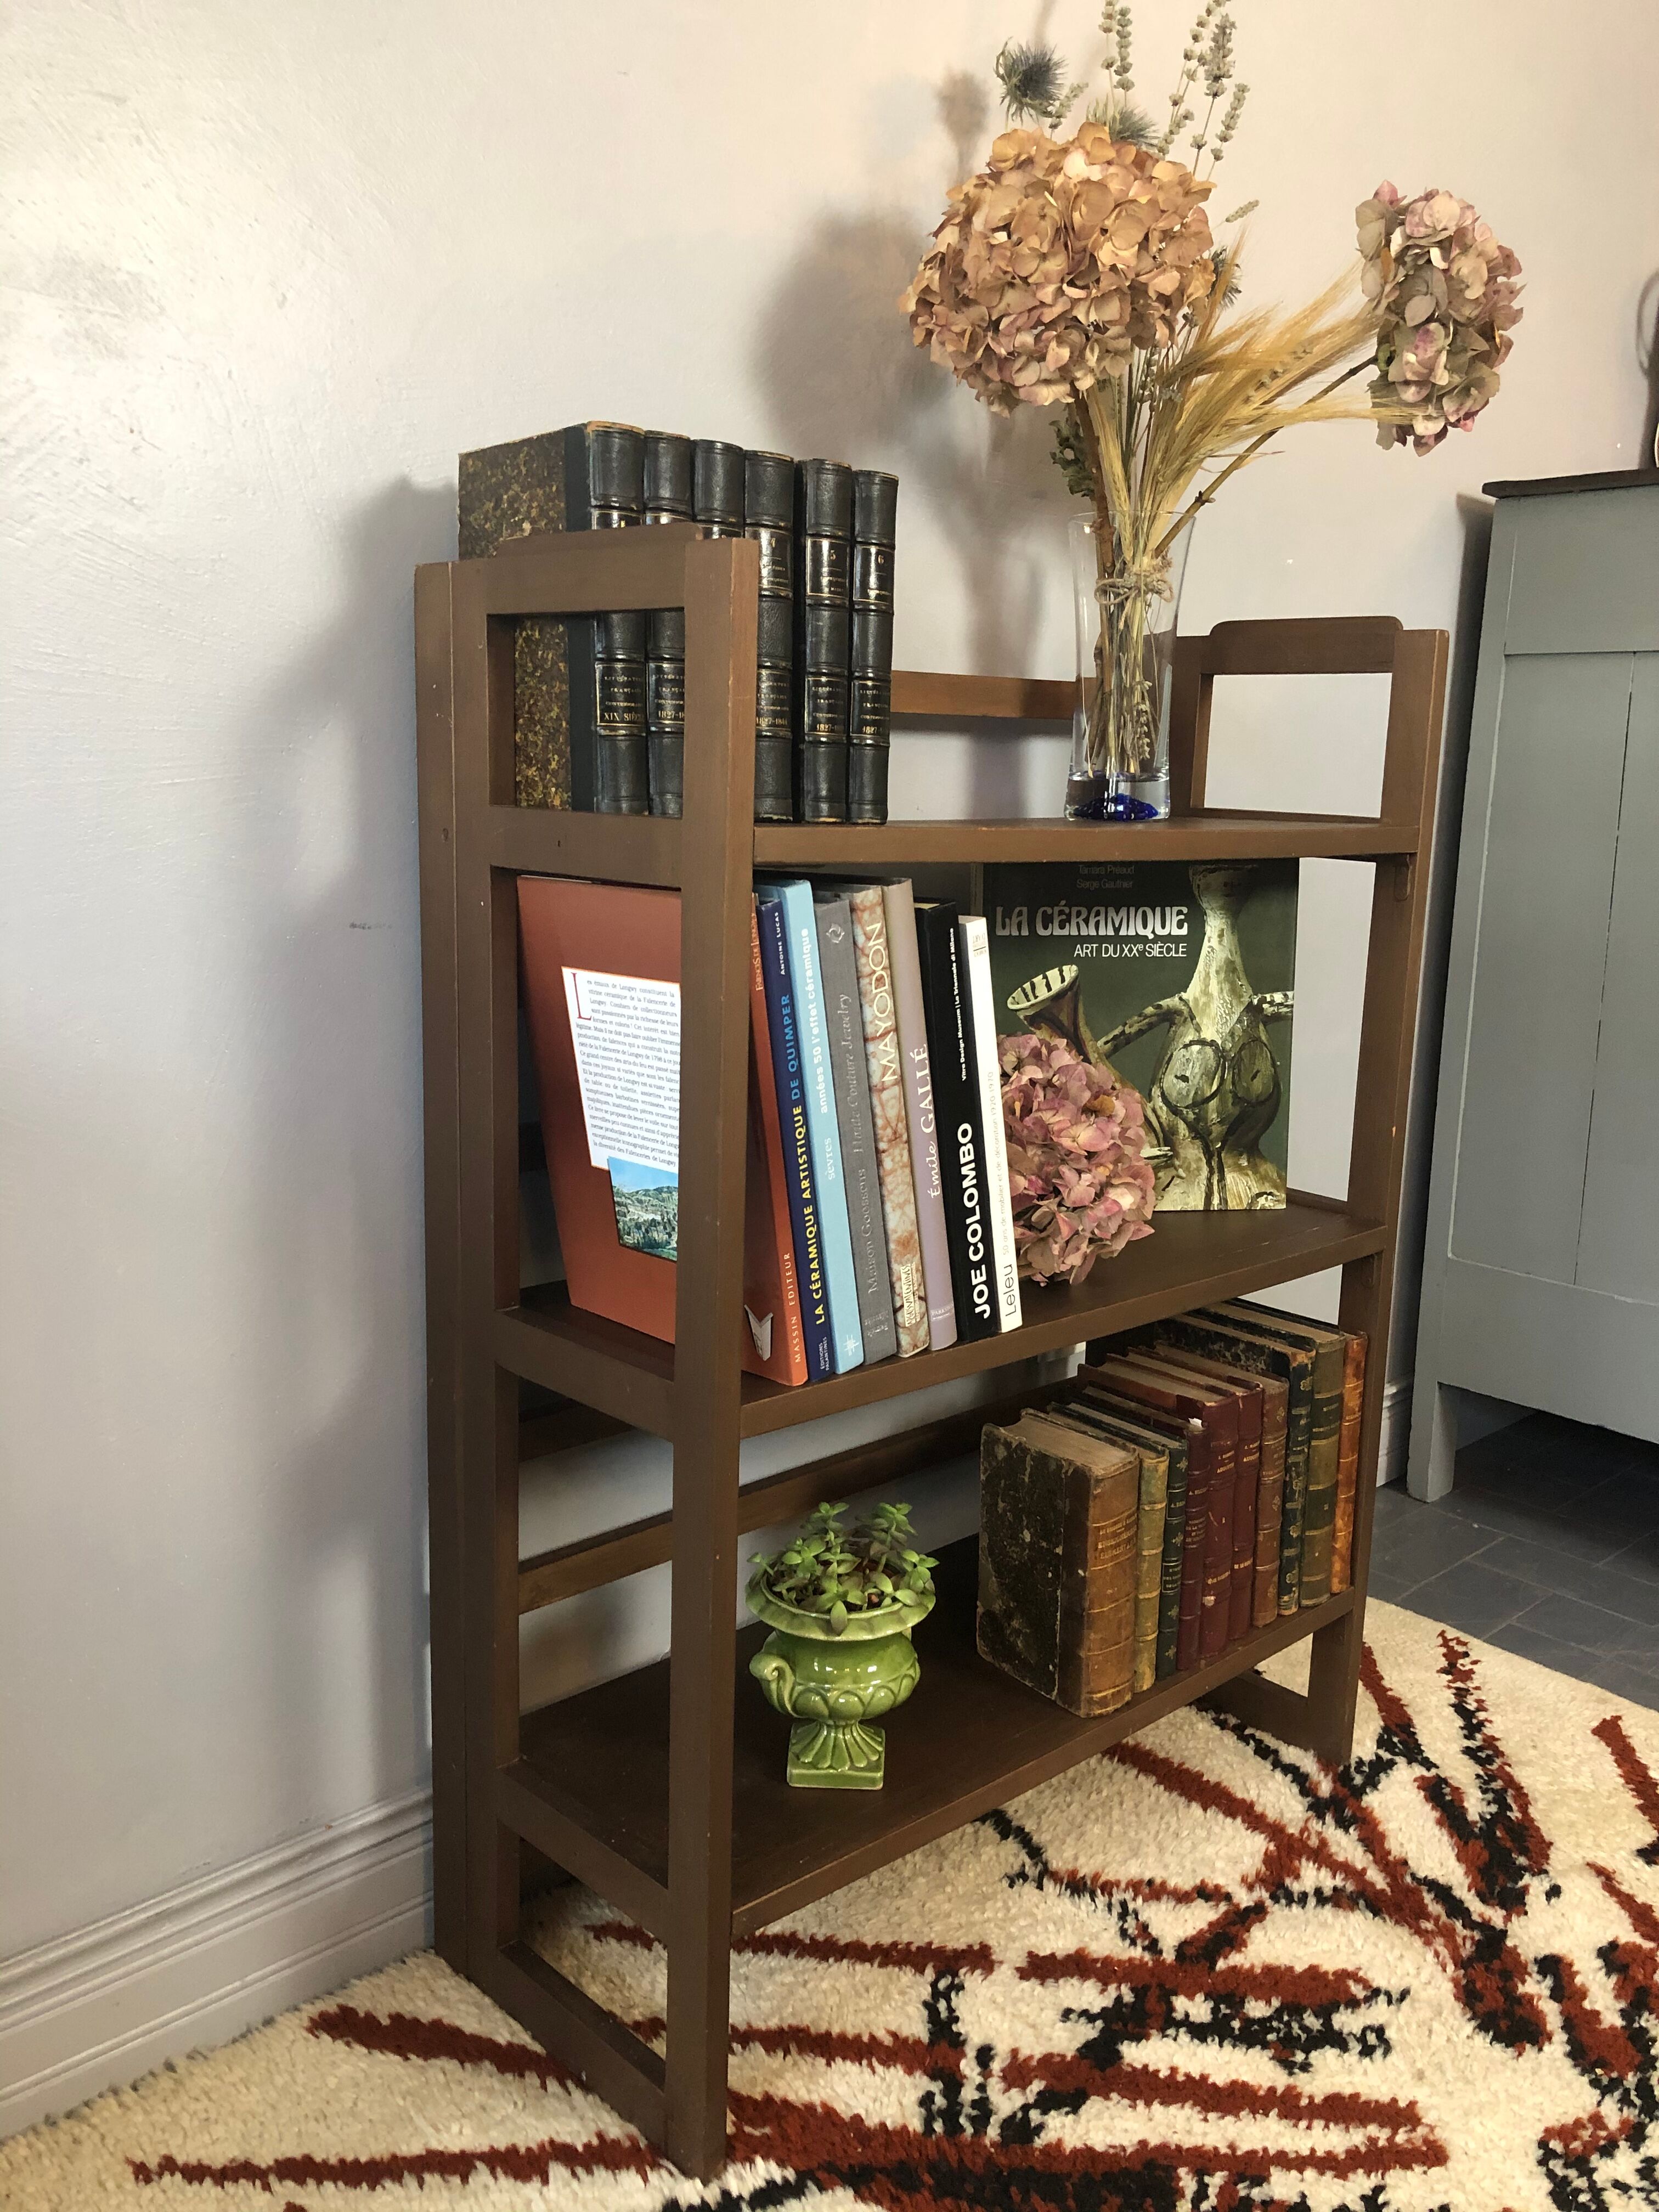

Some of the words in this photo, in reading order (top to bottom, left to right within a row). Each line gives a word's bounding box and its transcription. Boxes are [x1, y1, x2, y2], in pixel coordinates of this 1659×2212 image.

[605, 712, 619, 721] XIX
[1076, 879, 1099, 890] Serge
[1101, 878, 1133, 889] Gauthier
[995, 906, 1029, 936] LA
[1035, 900, 1188, 940] CÉRAMIQUE
[802, 928, 816, 1000] céramique
[1074, 944, 1099, 957] ART
[1102, 944, 1120, 957] DU
[1146, 940, 1187, 957] SIÈCLE
[806, 1001, 821, 1045] l'effet
[837, 994, 852, 1049] Jewelry
[866, 922, 897, 1081] MAYODON
[955, 995, 960, 1005] La
[781, 994, 798, 1072] QUIMPER
[813, 1047, 822, 1068] 50
[792, 1081, 800, 1101] DE
[815, 1072, 828, 1113] années
[845, 1055, 858, 1107] Couture
[910, 1043, 934, 1133] GALLÉ
[793, 1105, 811, 1199] ARTISTIQUE
[824, 1137, 835, 1180] sèvres
[926, 1141, 941, 1198] Émile
[996, 1161, 1002, 1171] de
[859, 1169, 872, 1237] Goossens
[957, 1122, 984, 1261] COLOMBO
[1001, 1217, 1007, 1227] de
[804, 1204, 823, 1300] CÉRAMIQUE
[866, 1241, 878, 1294] Maison
[1003, 1245, 1009, 1255] 50
[783, 1252, 794, 1306] EDITEUR
[971, 1264, 991, 1319] JOE
[1004, 1264, 1017, 1317] Leleu
[815, 1304, 825, 1324] LA
[788, 1316, 802, 1363] MASSIN
